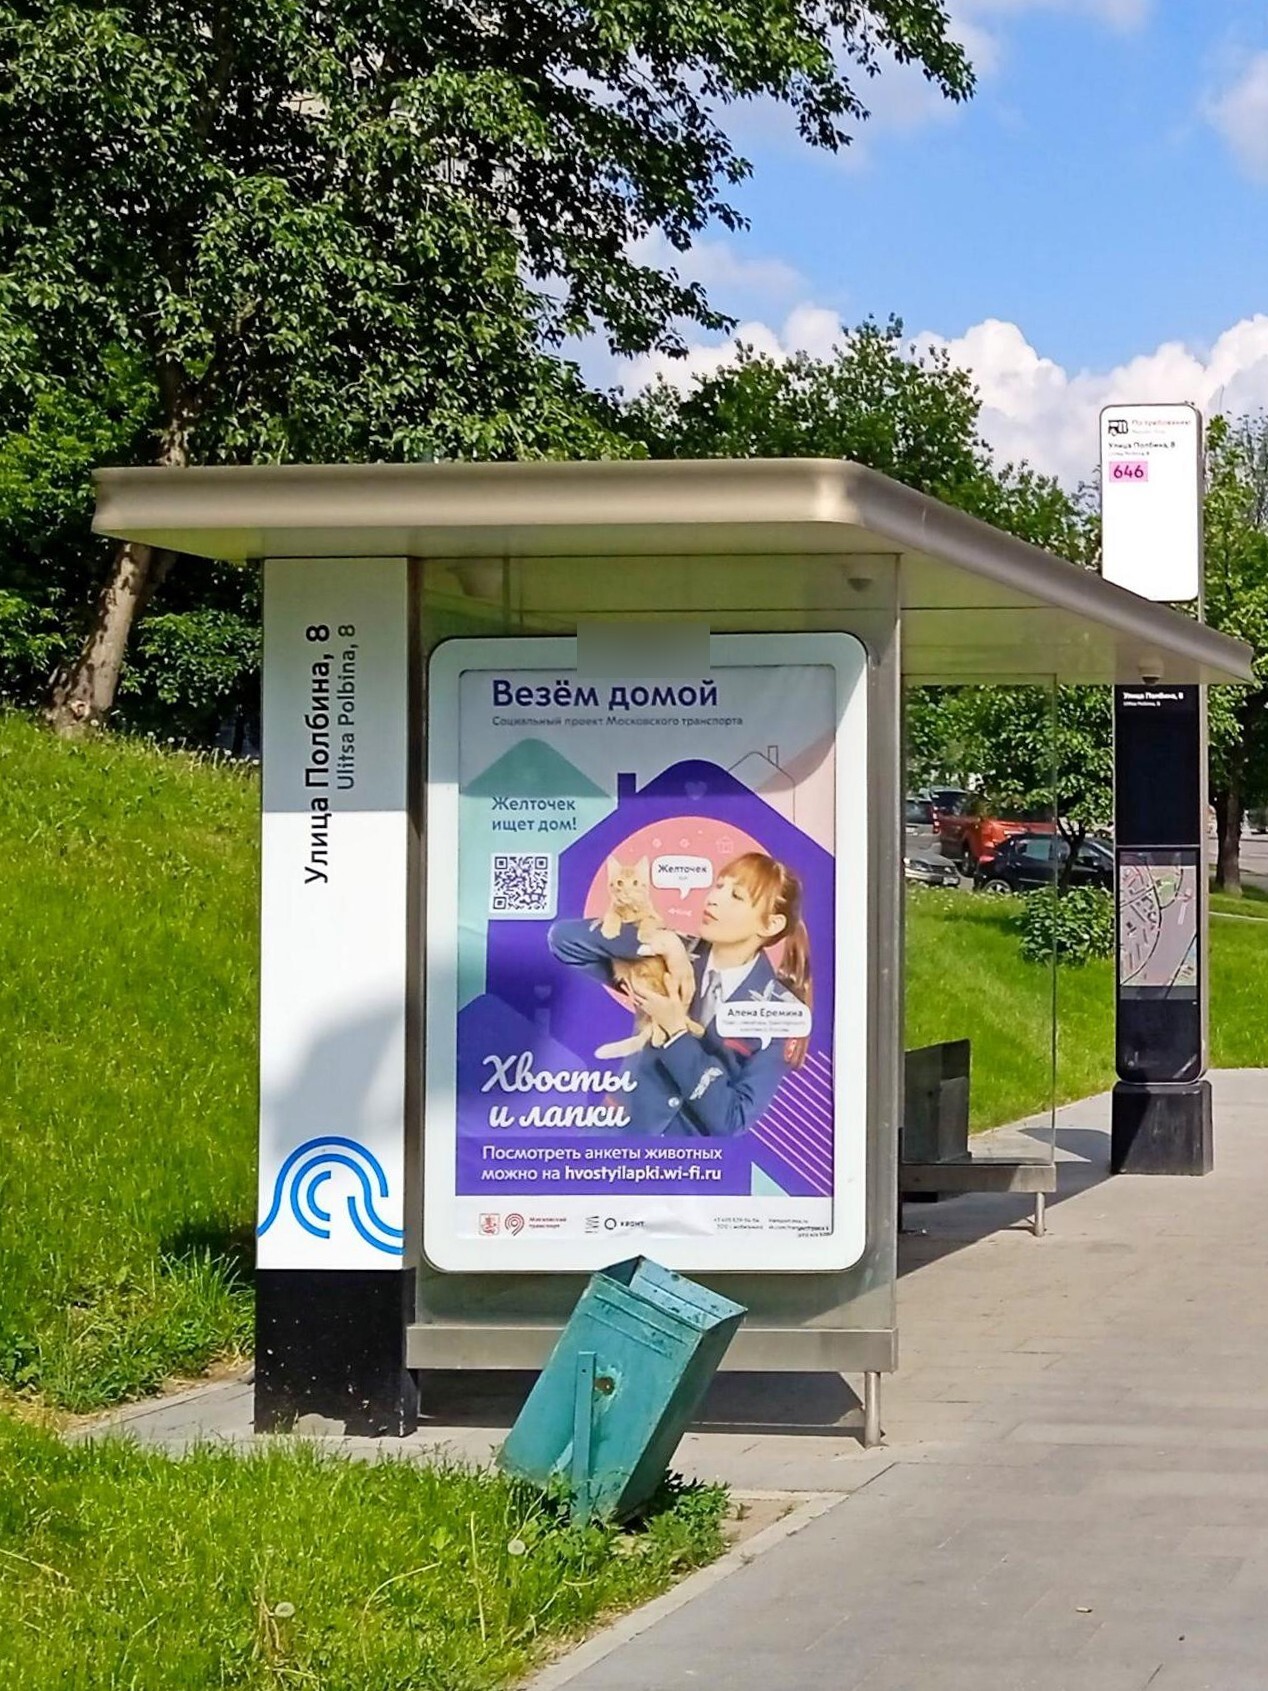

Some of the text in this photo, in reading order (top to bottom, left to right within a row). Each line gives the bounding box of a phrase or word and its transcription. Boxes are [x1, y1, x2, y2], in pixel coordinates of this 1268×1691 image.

[1113, 465, 1144, 479] 646
[492, 679, 719, 711] Везём домой
[337, 624, 359, 790] Ulitsa Polbina, 8
[492, 716, 744, 728] Социальный проект Московского транспорта
[304, 623, 335, 885] Улица Полбина, 8
[491, 796, 577, 811] Желточек
[491, 817, 577, 833] ищет дом!
[657, 863, 708, 875] Желточек
[760, 1008, 804, 1018] Еремина
[480, 1050, 639, 1093] Хвосты
[488, 1105, 632, 1128] и лапки
[482, 1146, 723, 1162] Посмотреть анкеты животных
[481, 1165, 723, 1183] можно на hvostyilapki.wi-fi.ru
